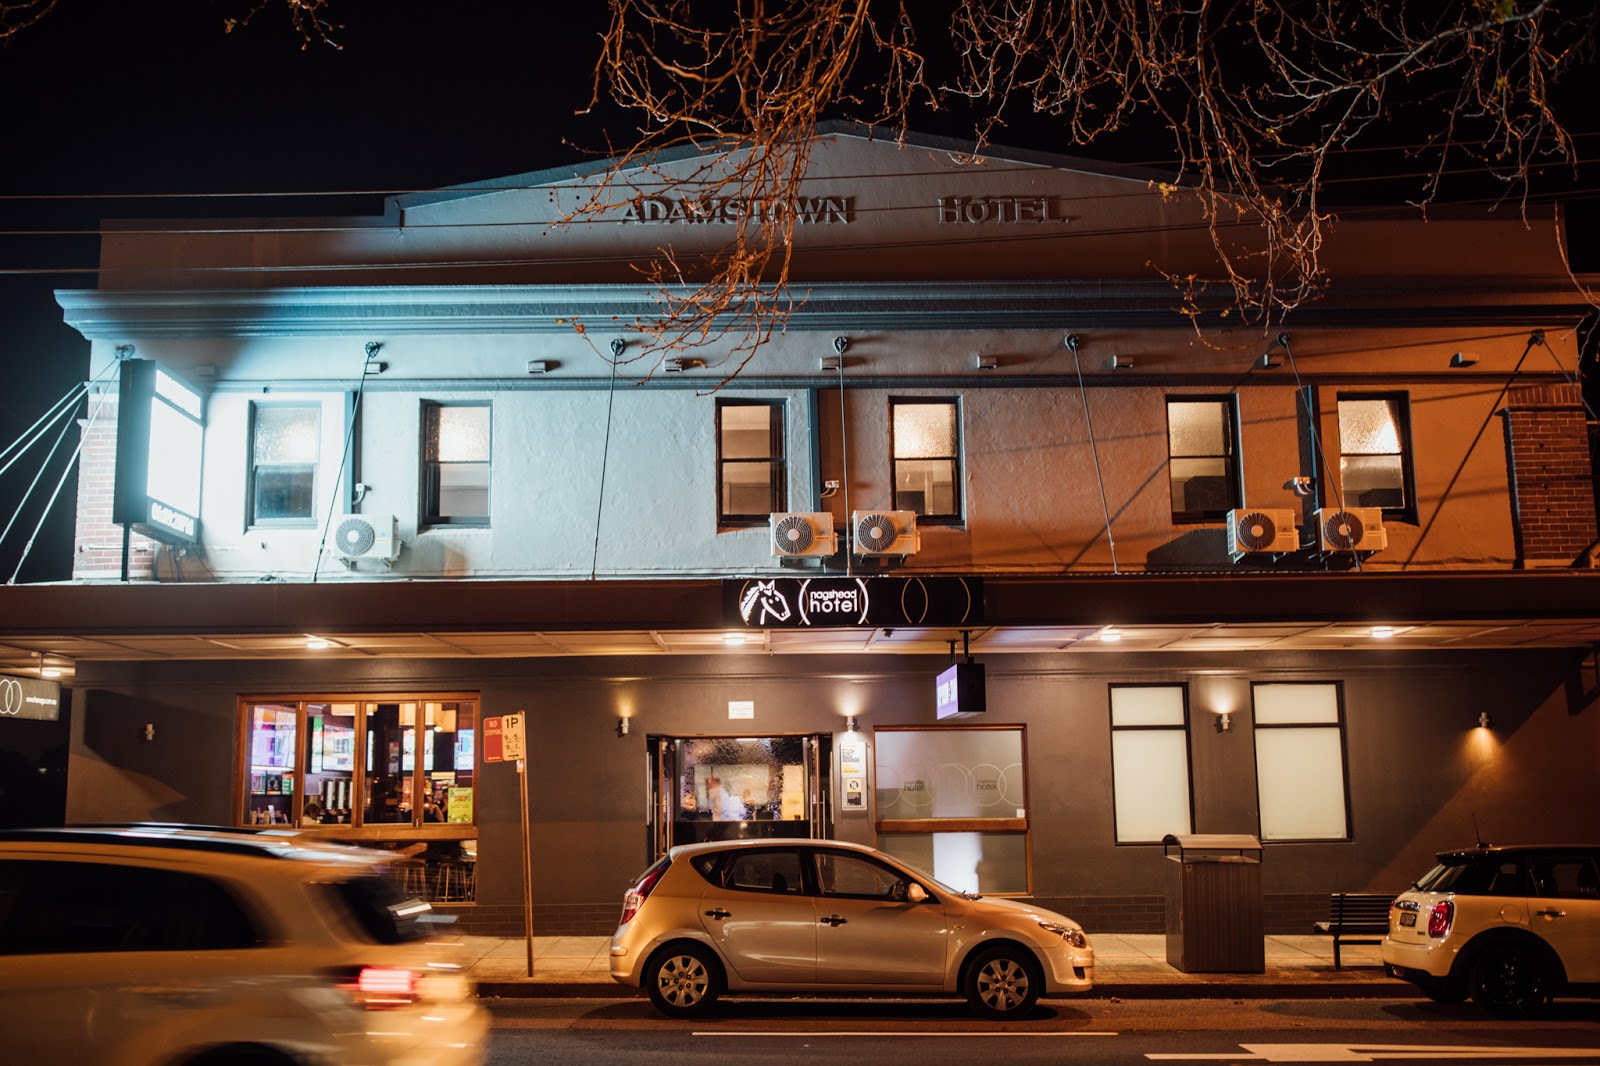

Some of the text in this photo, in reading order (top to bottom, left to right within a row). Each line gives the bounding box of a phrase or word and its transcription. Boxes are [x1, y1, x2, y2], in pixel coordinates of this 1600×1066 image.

[617, 197, 851, 226] ADAMSTOWN
[810, 589, 857, 600] nagshead
[810, 598, 858, 613] hotel
[489, 720, 498, 728] NO
[506, 717, 518, 728] 1P
[903, 782, 925, 792] hotel
[976, 782, 997, 791] hotel
